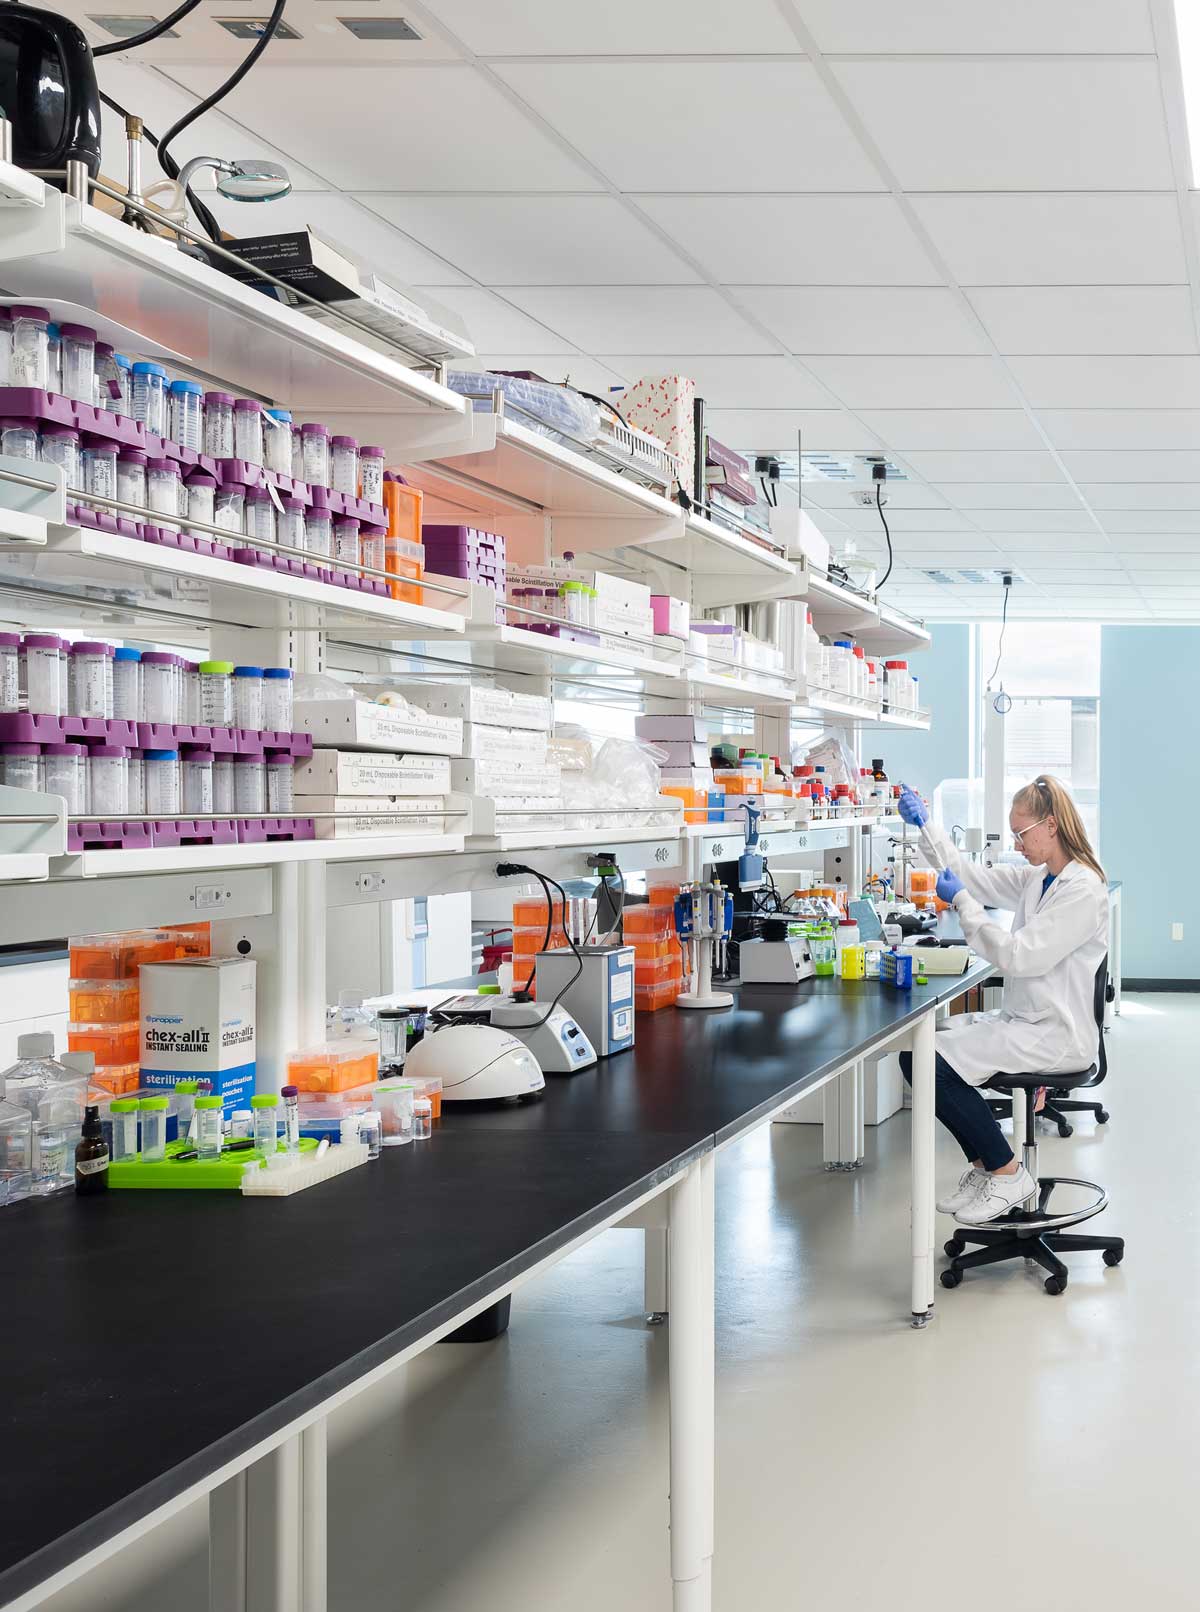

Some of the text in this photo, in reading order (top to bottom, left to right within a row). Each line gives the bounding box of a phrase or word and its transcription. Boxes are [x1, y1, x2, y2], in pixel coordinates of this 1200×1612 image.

[152, 1016, 184, 1024] propper
[146, 1042, 208, 1053] INSTANT SEALING
[222, 1075, 253, 1088] sterilization
